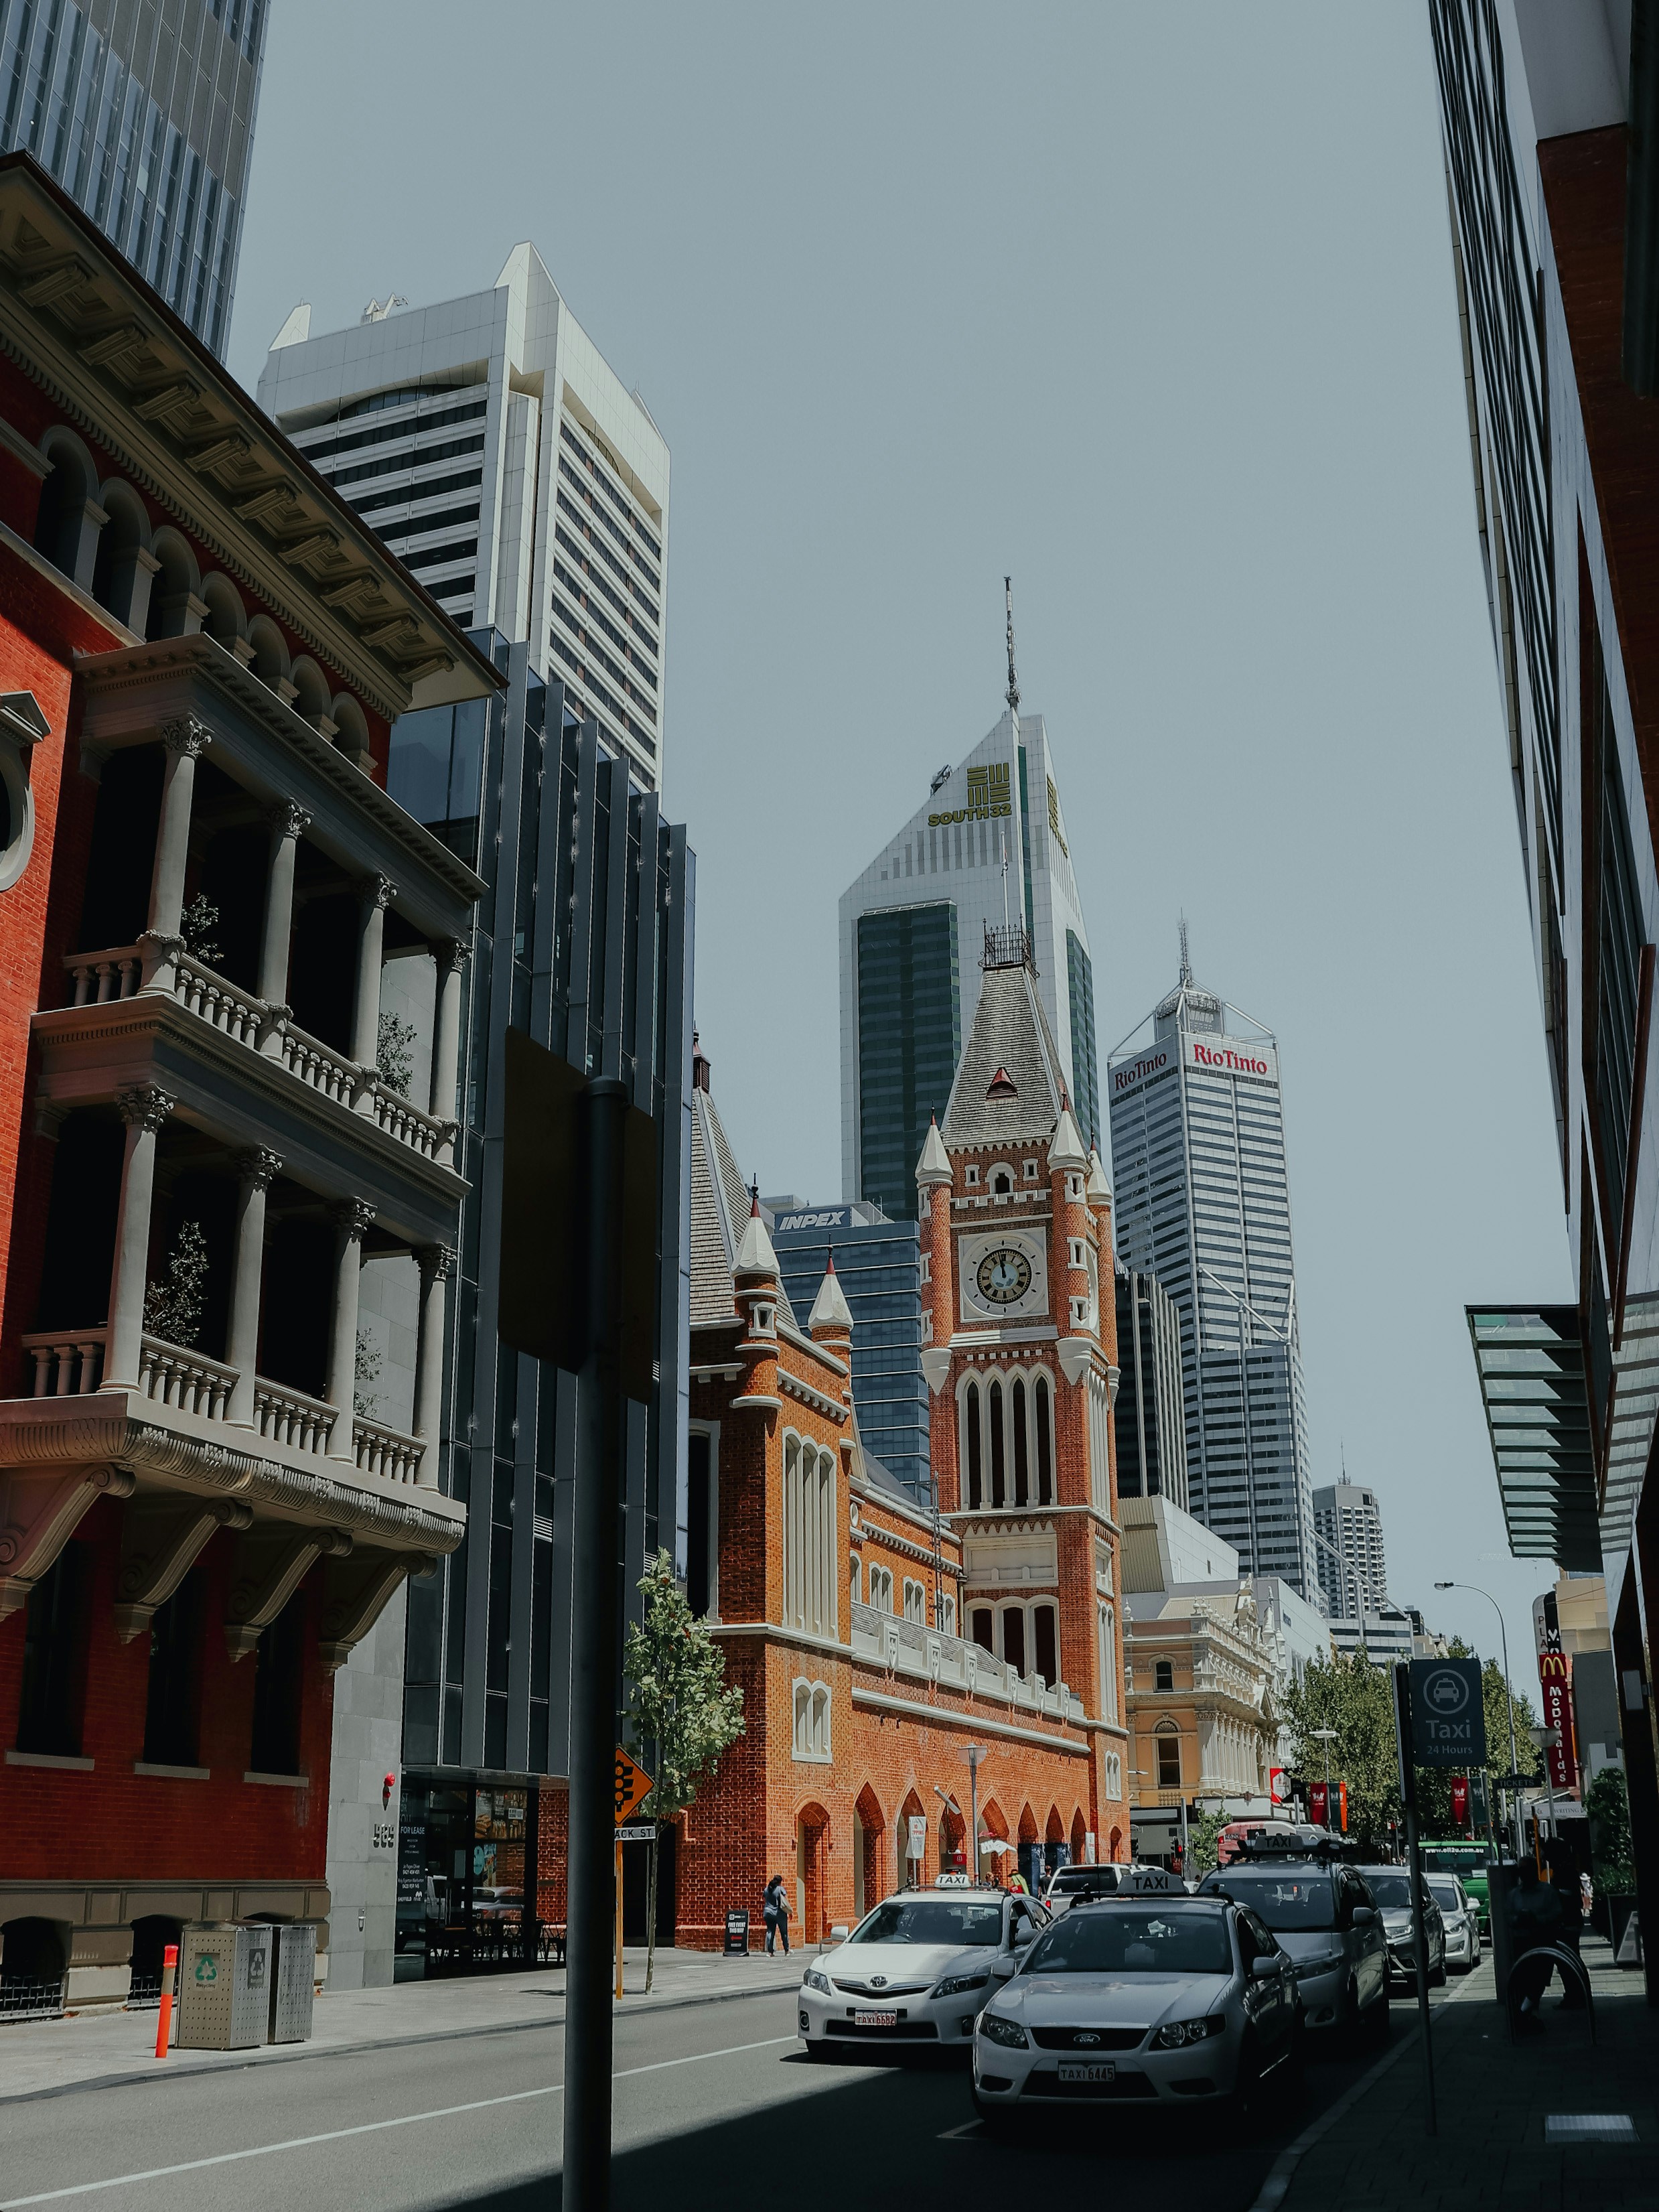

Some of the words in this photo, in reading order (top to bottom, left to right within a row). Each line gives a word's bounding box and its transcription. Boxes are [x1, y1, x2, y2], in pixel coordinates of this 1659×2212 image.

[779, 1211, 846, 1231] INPEX
[1425, 1719, 1471, 1738] Taxi
[1427, 1746, 1439, 1754] 24
[1443, 1745, 1473, 1754] Hours
[640, 1828, 652, 1838] ST
[1264, 1838, 1291, 1848] TAXI
[938, 1876, 966, 1884] TAXI
[1133, 1876, 1169, 1889] TAXI
[1061, 2069, 1085, 2079] TAXI
[1088, 2067, 1113, 2079] 6445
